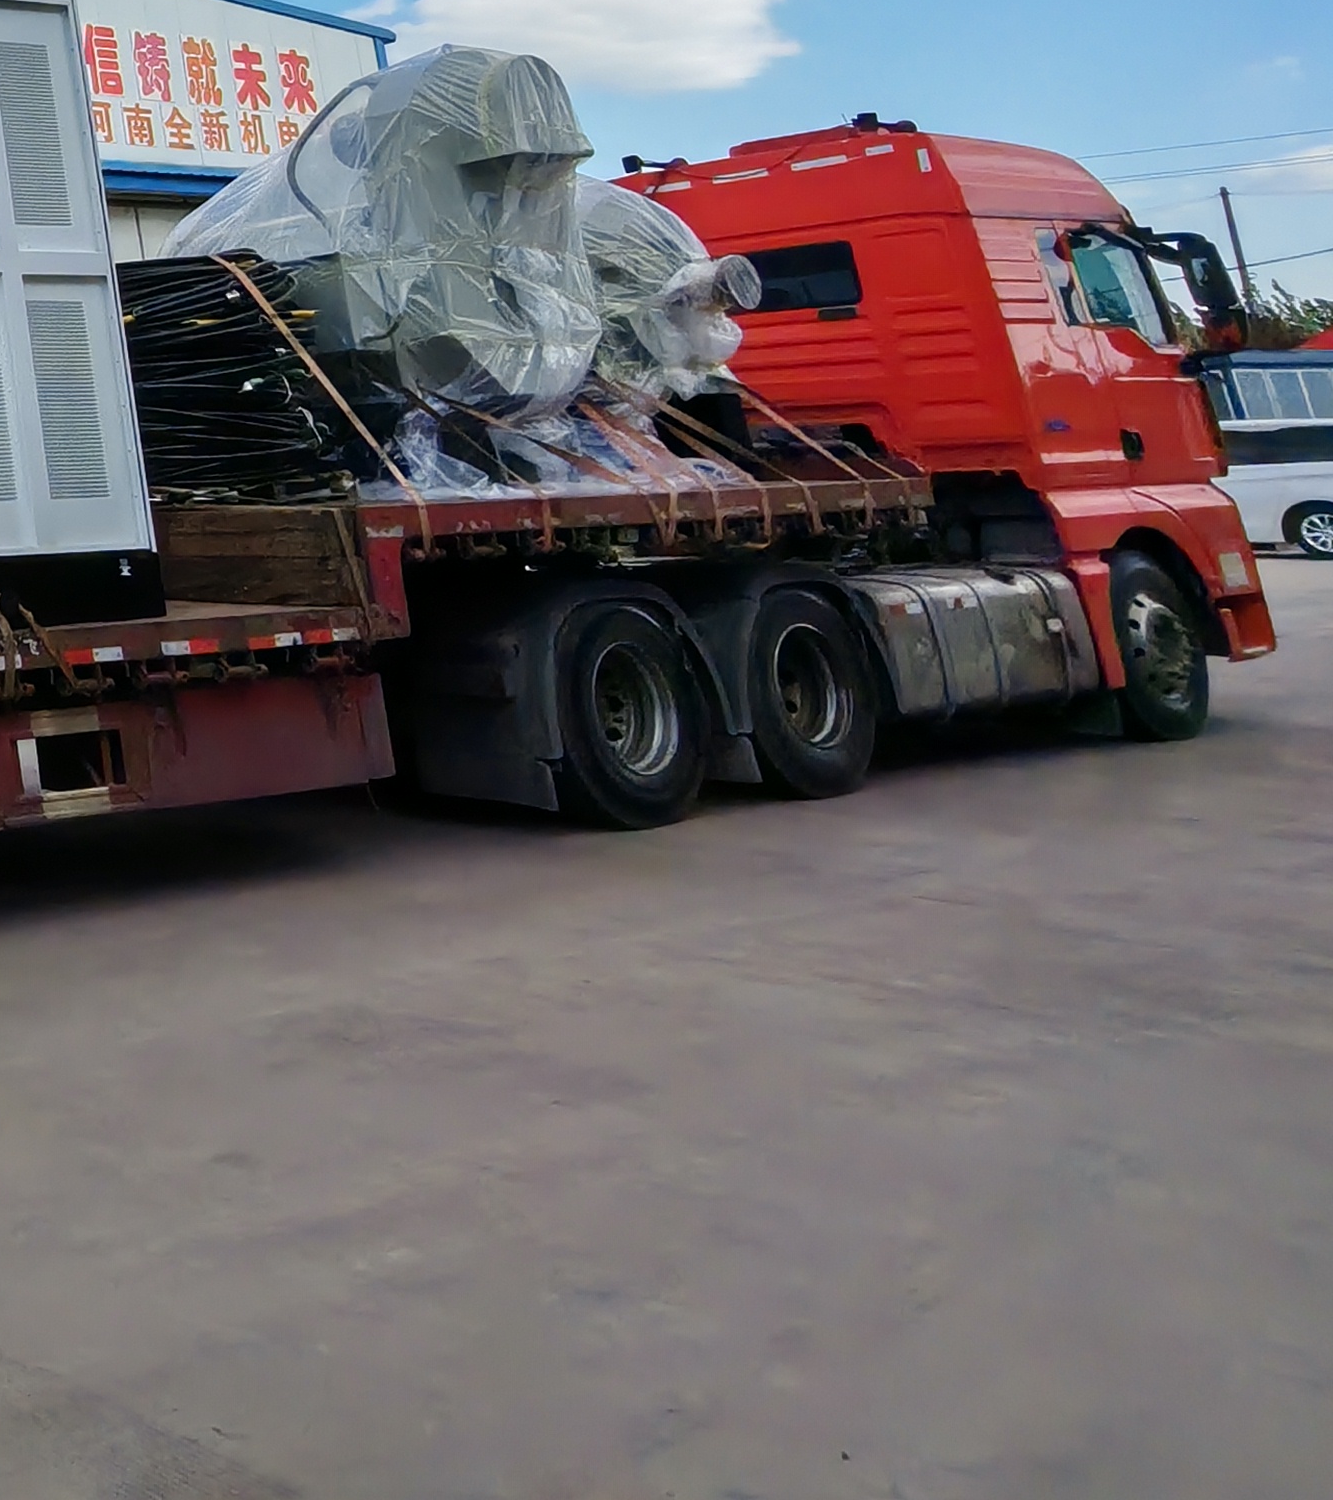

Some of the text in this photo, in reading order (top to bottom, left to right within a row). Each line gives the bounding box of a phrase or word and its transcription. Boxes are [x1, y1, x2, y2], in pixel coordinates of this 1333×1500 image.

[84, 23, 318, 114] 信铸就未来
